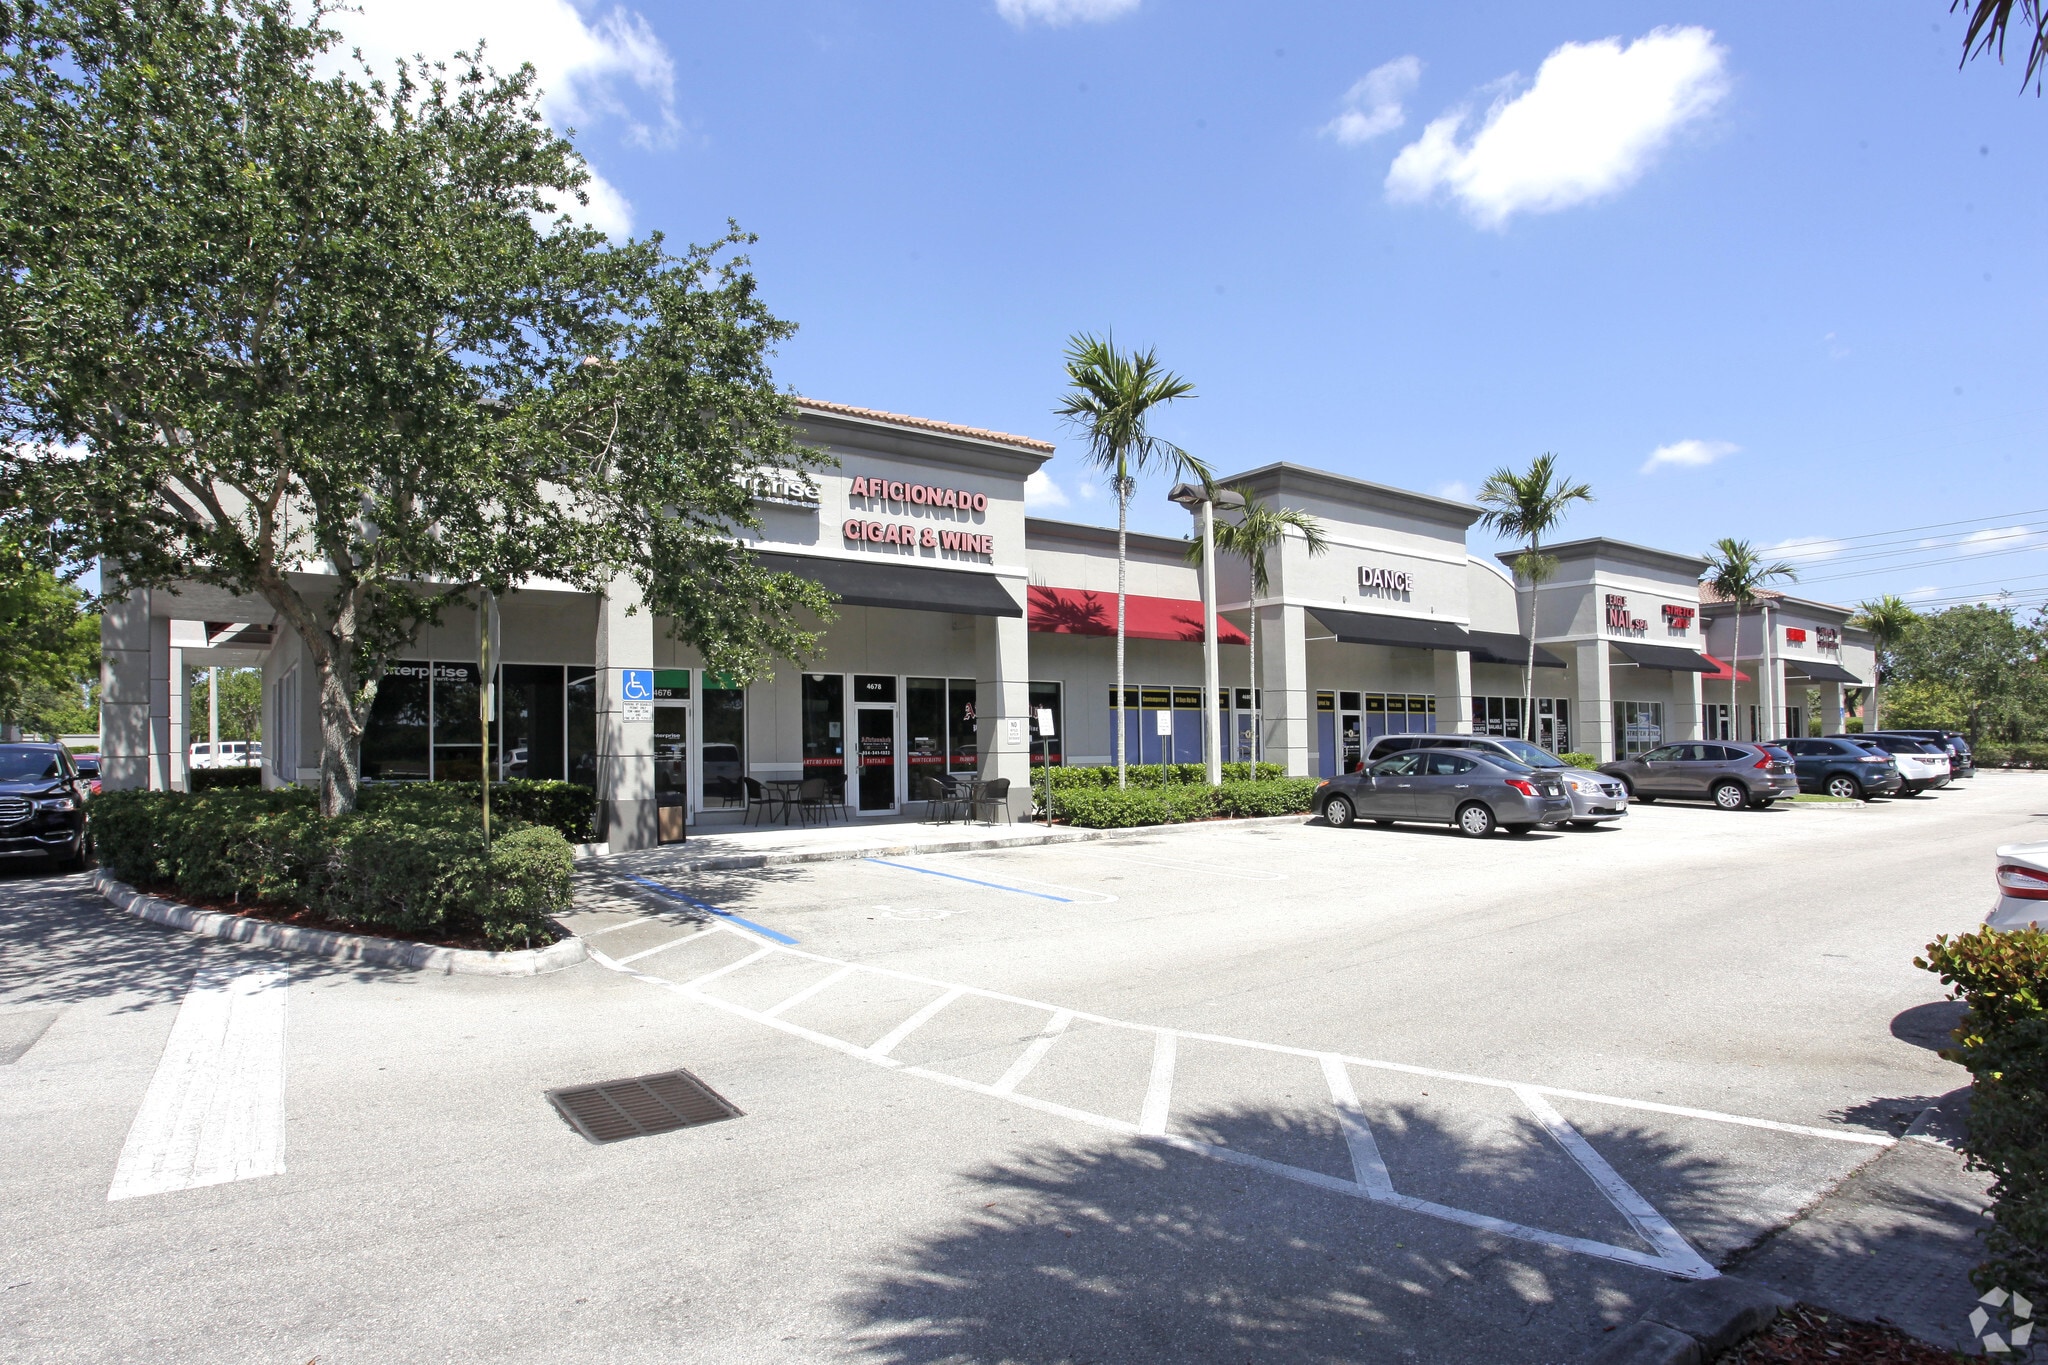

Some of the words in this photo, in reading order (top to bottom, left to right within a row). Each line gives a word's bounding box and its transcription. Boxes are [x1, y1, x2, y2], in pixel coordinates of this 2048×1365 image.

[851, 475, 988, 512] AFICIONADO
[844, 519, 916, 545] CIGAR
[921, 528, 937, 548] &
[941, 530, 994, 554] WINE
[1360, 566, 1414, 592] DANCE
[1609, 594, 1627, 607] EAGLE
[1664, 605, 1695, 618] STRETCH
[1609, 608, 1635, 629] NAIL
[1634, 619, 1648, 630] SPA
[1671, 617, 1691, 629] ZONE
[383, 665, 468, 679] terprise
[654, 689, 672, 697] 4676
